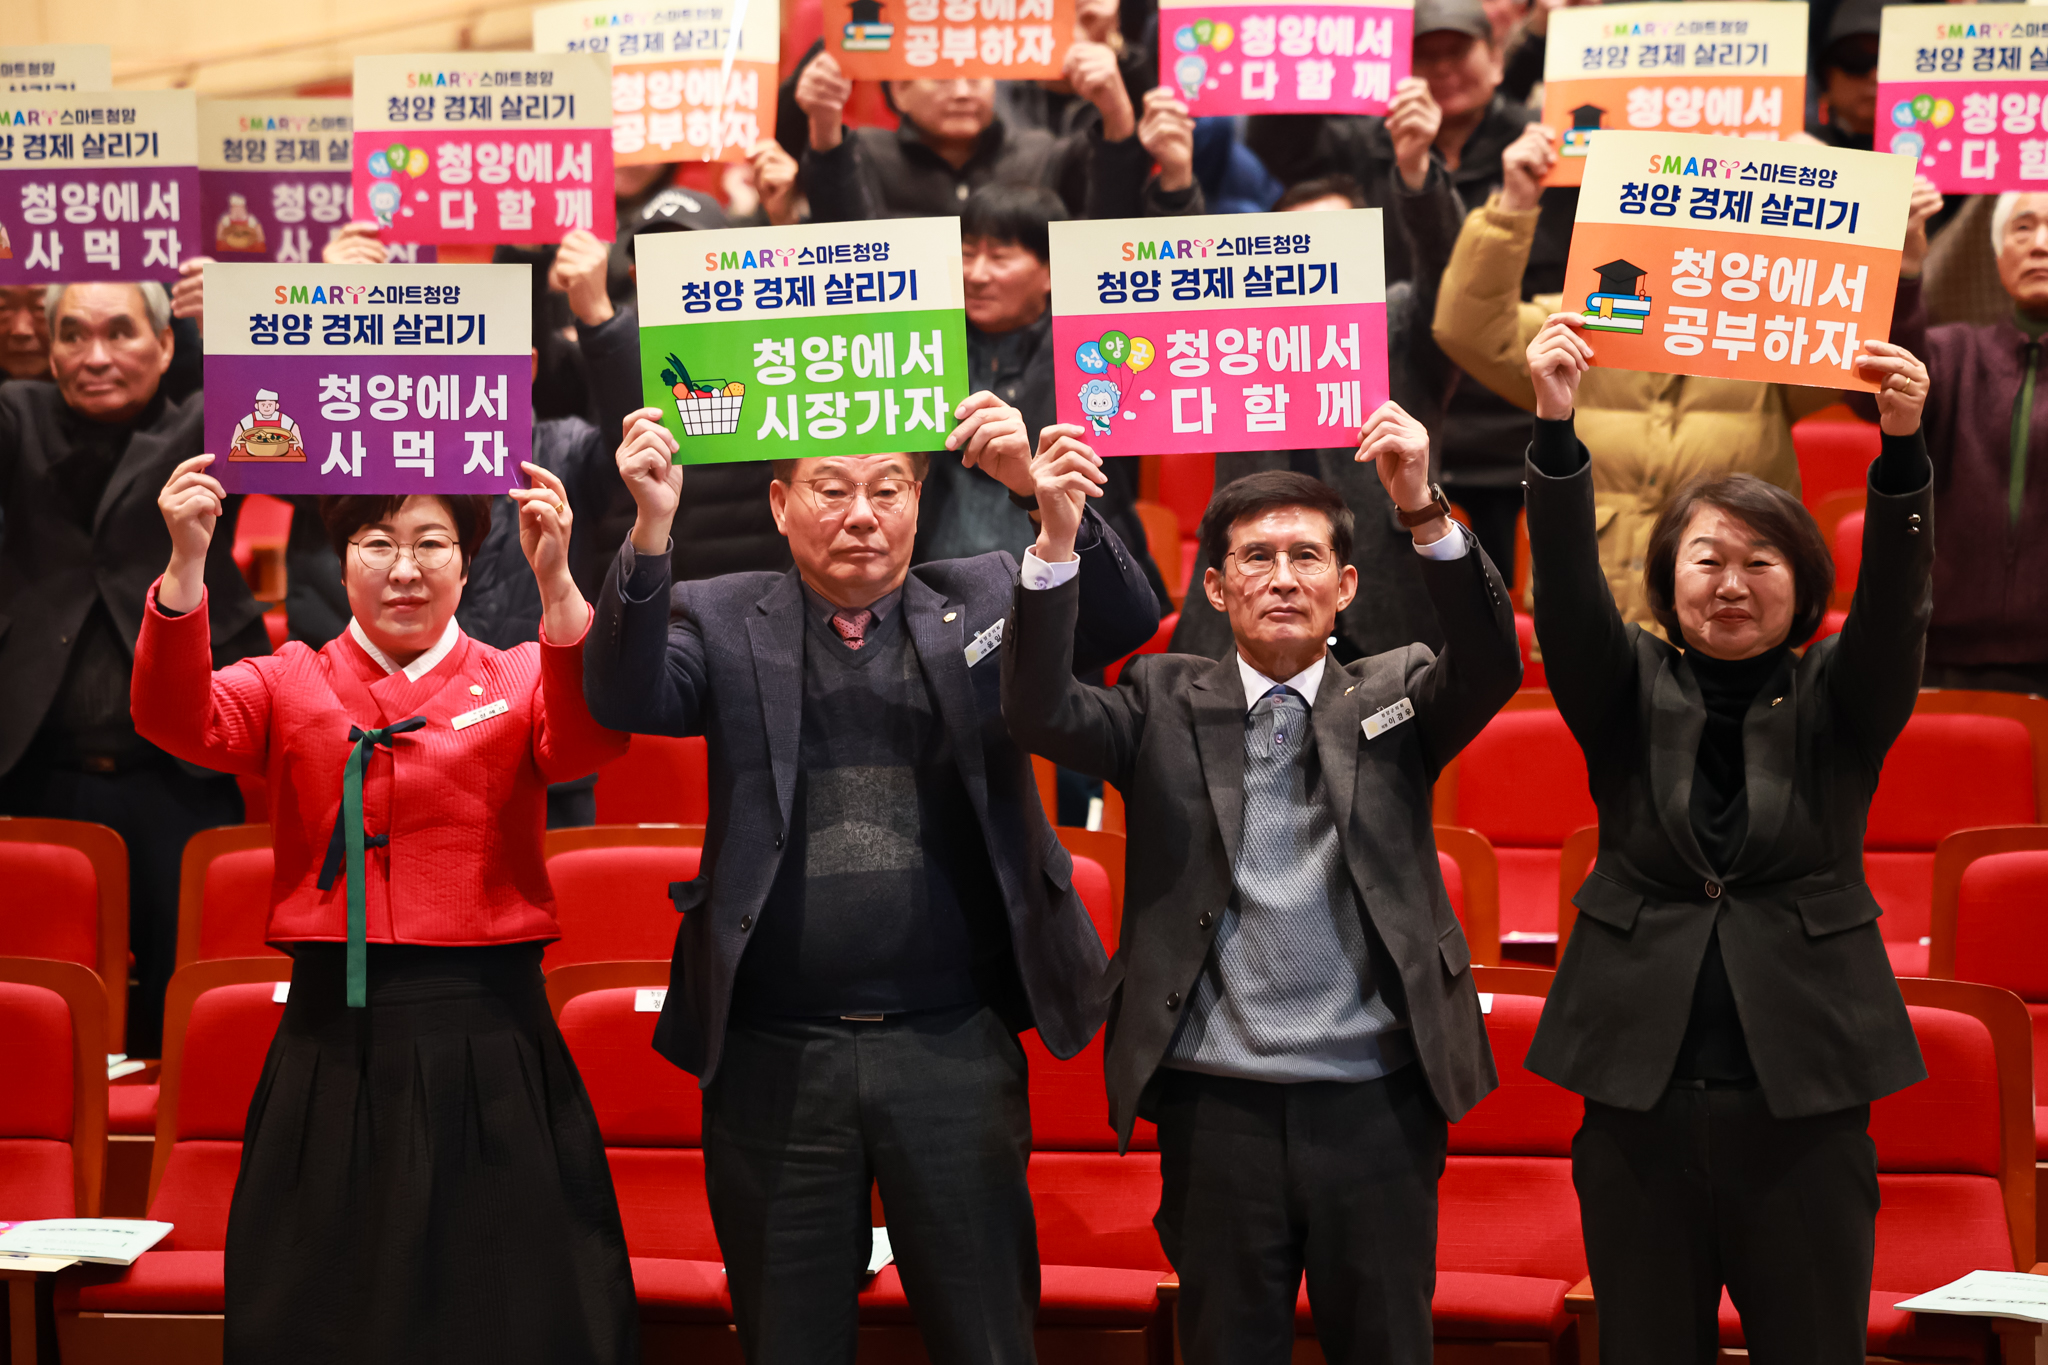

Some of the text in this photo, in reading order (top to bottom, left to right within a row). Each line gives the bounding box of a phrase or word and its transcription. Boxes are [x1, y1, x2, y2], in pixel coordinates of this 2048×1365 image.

[904, 25, 1055, 68] 공부하자
[1240, 14, 1393, 57] 청양에서
[1582, 43, 1768, 70] 청양 경제 살리기
[1916, 47, 1964, 72] 청양
[1973, 47, 2021, 71] 경제
[388, 95, 575, 121] 청양 경제 살리기
[612, 67, 758, 112] 청양에서
[1626, 85, 1783, 129] 청양에서
[60, 108, 136, 125] 스마트청양
[23, 133, 74, 160] 경제
[82, 132, 159, 159] 살리기
[223, 138, 266, 163] 청양
[275, 138, 320, 163] 경제
[436, 142, 593, 184] 청양에서
[1739, 160, 1838, 189] 스마트청양
[20, 180, 180, 225] 청양에서
[1619, 181, 1860, 234] 청양 경제 살리기
[797, 241, 891, 267] 스마트청양
[1215, 233, 1312, 259] 스마트청양
[367, 284, 461, 306] 스마트청양
[680, 268, 919, 315] 청양 경제 살리기
[1096, 261, 1339, 304] 청양 경제 살리기
[1670, 247, 1869, 313] 청양에서
[248, 313, 487, 346] 청양 경제 살리기
[1166, 323, 1361, 378] 청양에서
[1662, 305, 1860, 370] 공부하자
[752, 328, 945, 386] 청양에서
[317, 373, 509, 422] 청양에서
[756, 386, 950, 442] 시장가자
